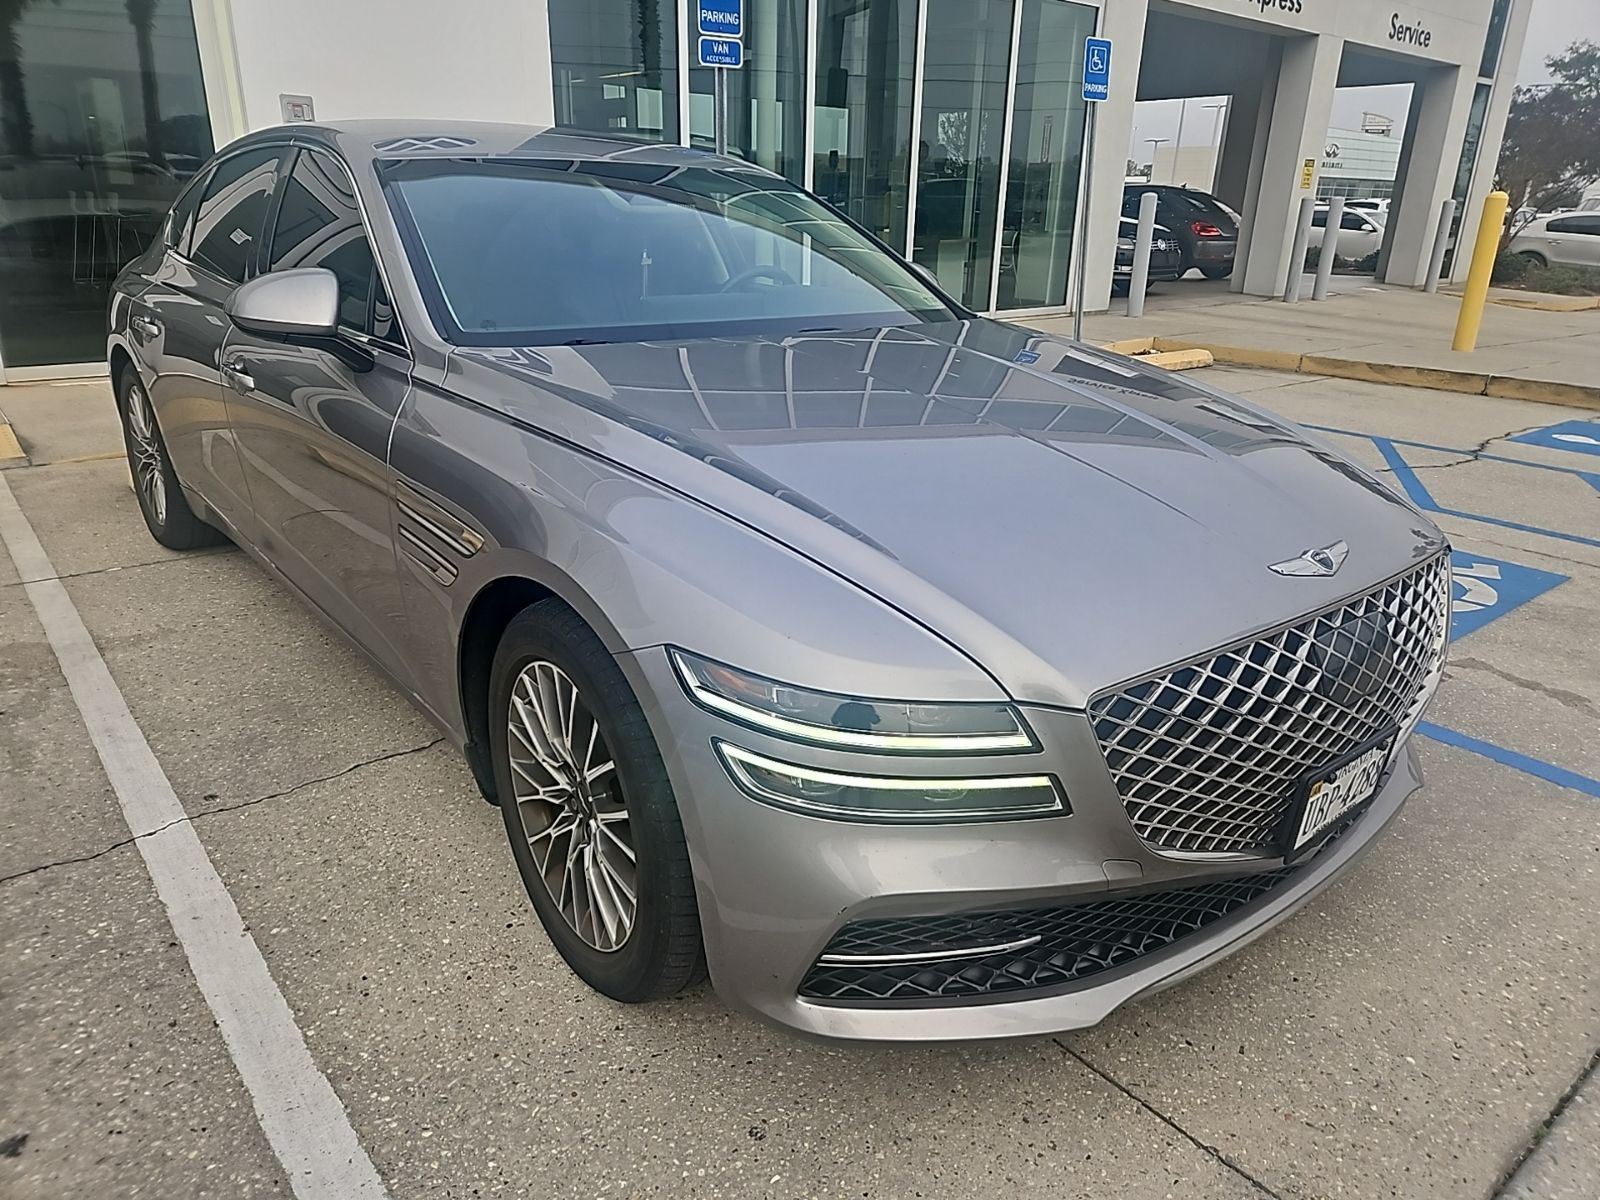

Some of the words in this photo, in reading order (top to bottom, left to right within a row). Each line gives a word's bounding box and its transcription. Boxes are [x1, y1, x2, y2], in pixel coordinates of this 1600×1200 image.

[1249, 0, 1302, 13] pess
[701, 10, 740, 25] PARKING
[1389, 12, 1431, 48] Service
[712, 41, 729, 54] VAN
[1084, 83, 1107, 93] PARKING
